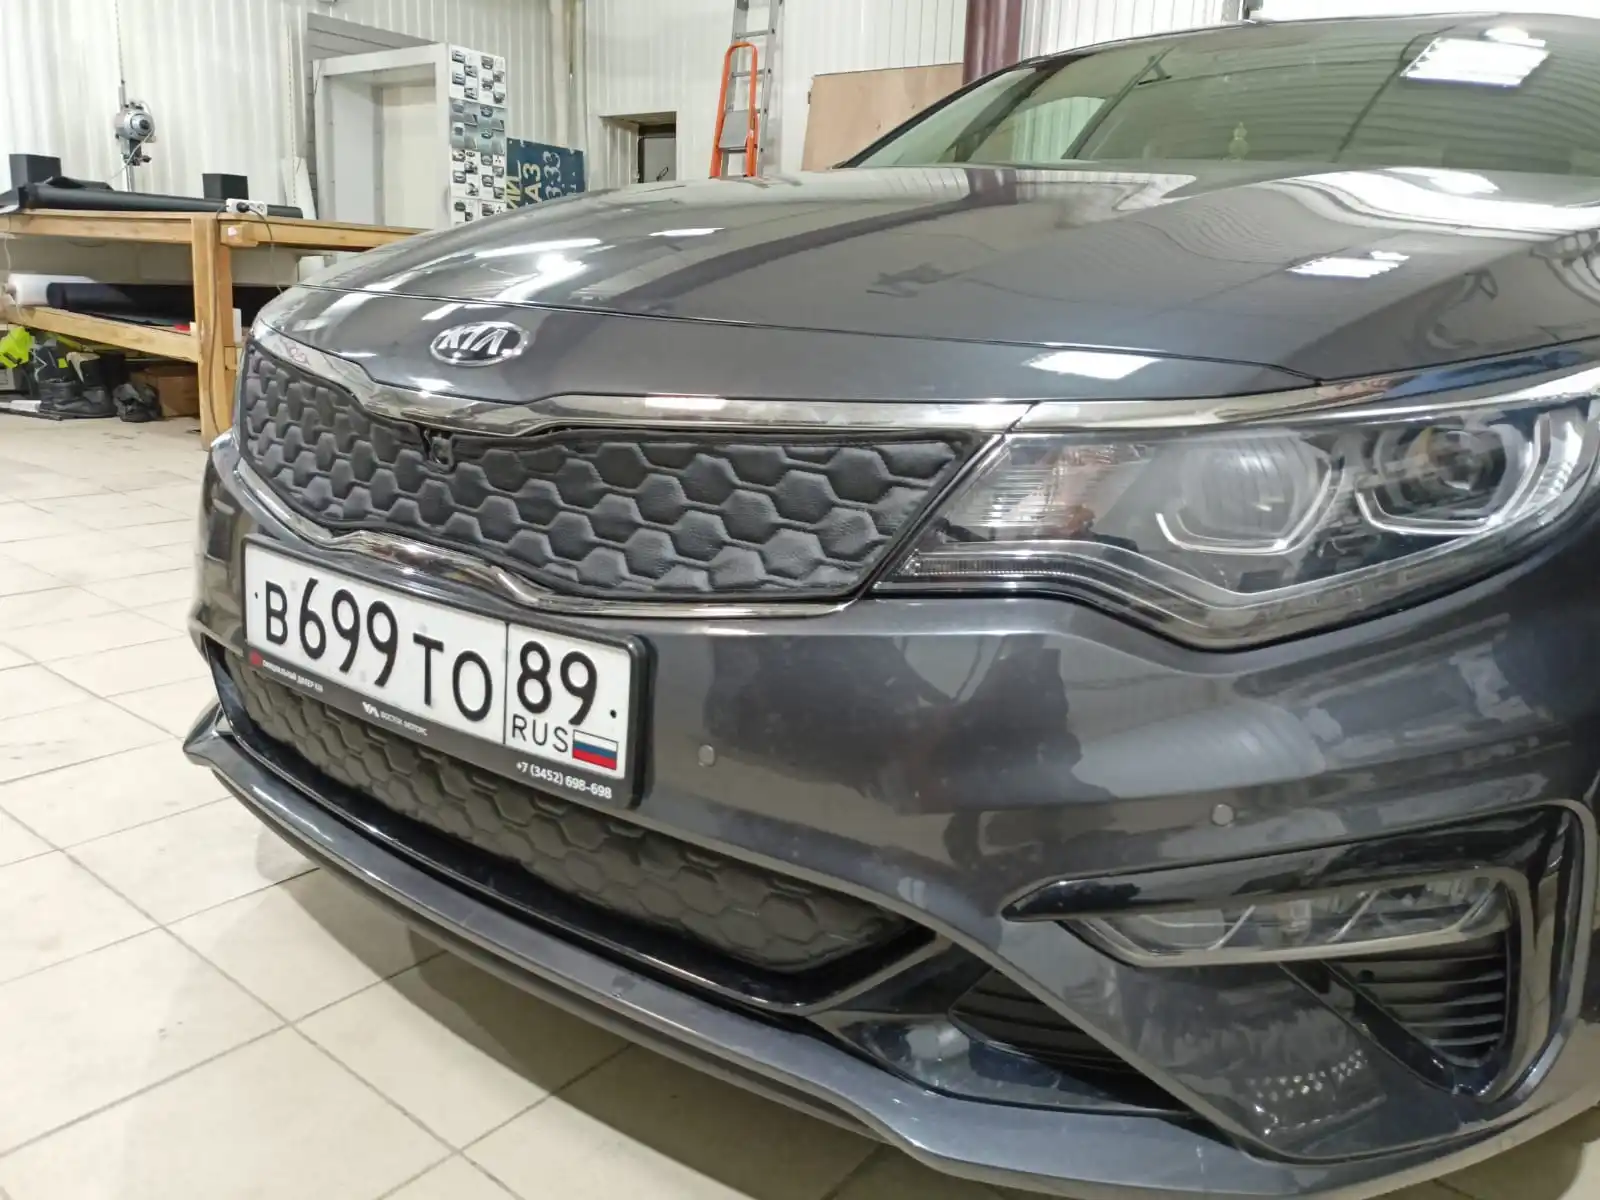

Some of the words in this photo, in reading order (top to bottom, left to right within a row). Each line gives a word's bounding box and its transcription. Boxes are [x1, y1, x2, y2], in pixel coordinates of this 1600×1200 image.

[437, 325, 509, 355] KIA
[517, 640, 598, 726] 89
[511, 713, 569, 753] RUS
[516, 761, 529, 773] +7
[530, 764, 564, 786] (3452)
[565, 775, 613, 800] 698-698
